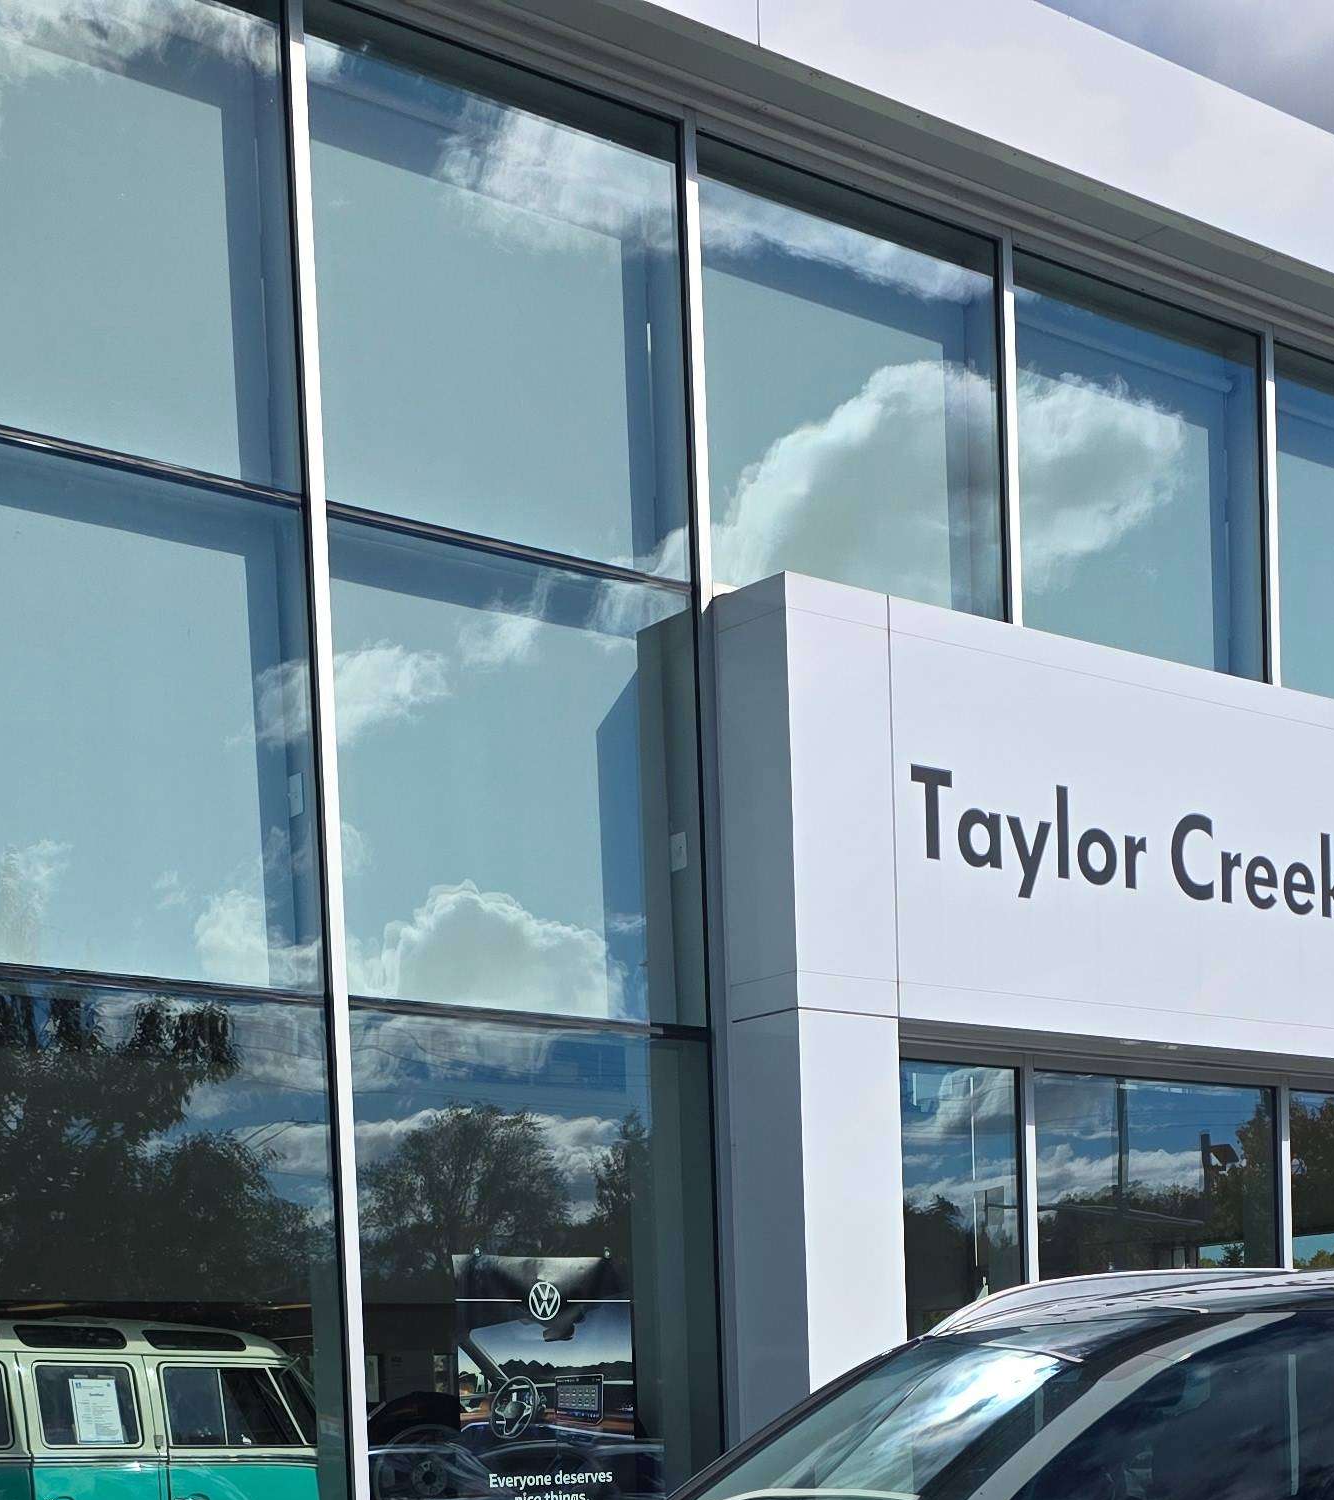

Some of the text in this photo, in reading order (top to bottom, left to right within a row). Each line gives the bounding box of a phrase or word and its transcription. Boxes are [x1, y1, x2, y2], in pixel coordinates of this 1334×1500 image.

[910, 763, 1147, 899] Taylor
[488, 1470, 613, 1491] Everyone deserves
